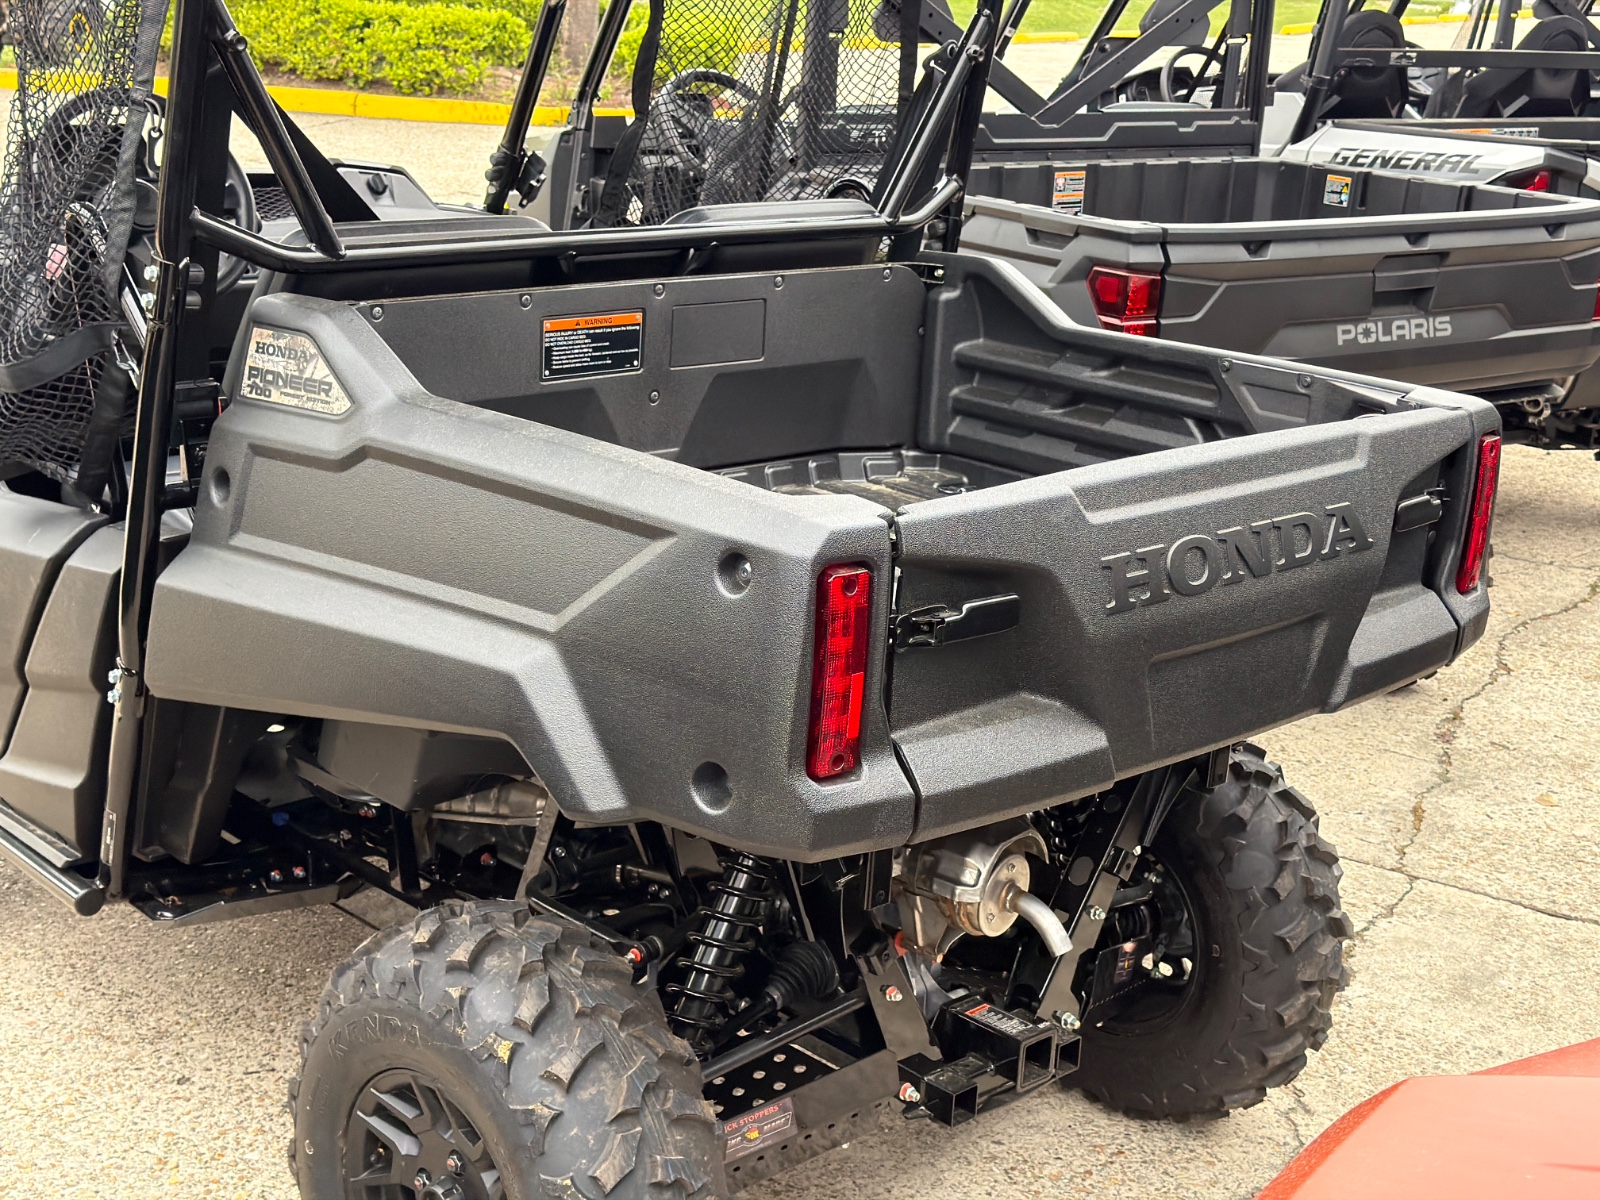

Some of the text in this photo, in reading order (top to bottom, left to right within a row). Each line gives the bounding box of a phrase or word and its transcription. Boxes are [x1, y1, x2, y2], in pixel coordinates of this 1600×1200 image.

[1332, 148, 1484, 175] GENERAL
[1336, 316, 1453, 346] POLARIS
[255, 341, 308, 361] HONDA
[247, 366, 333, 398] PIONEER
[247, 384, 272, 398] 700
[280, 391, 332, 405] FOREST EDITION
[1101, 501, 1374, 616] HONDA
[327, 1013, 424, 1061] KENDA
